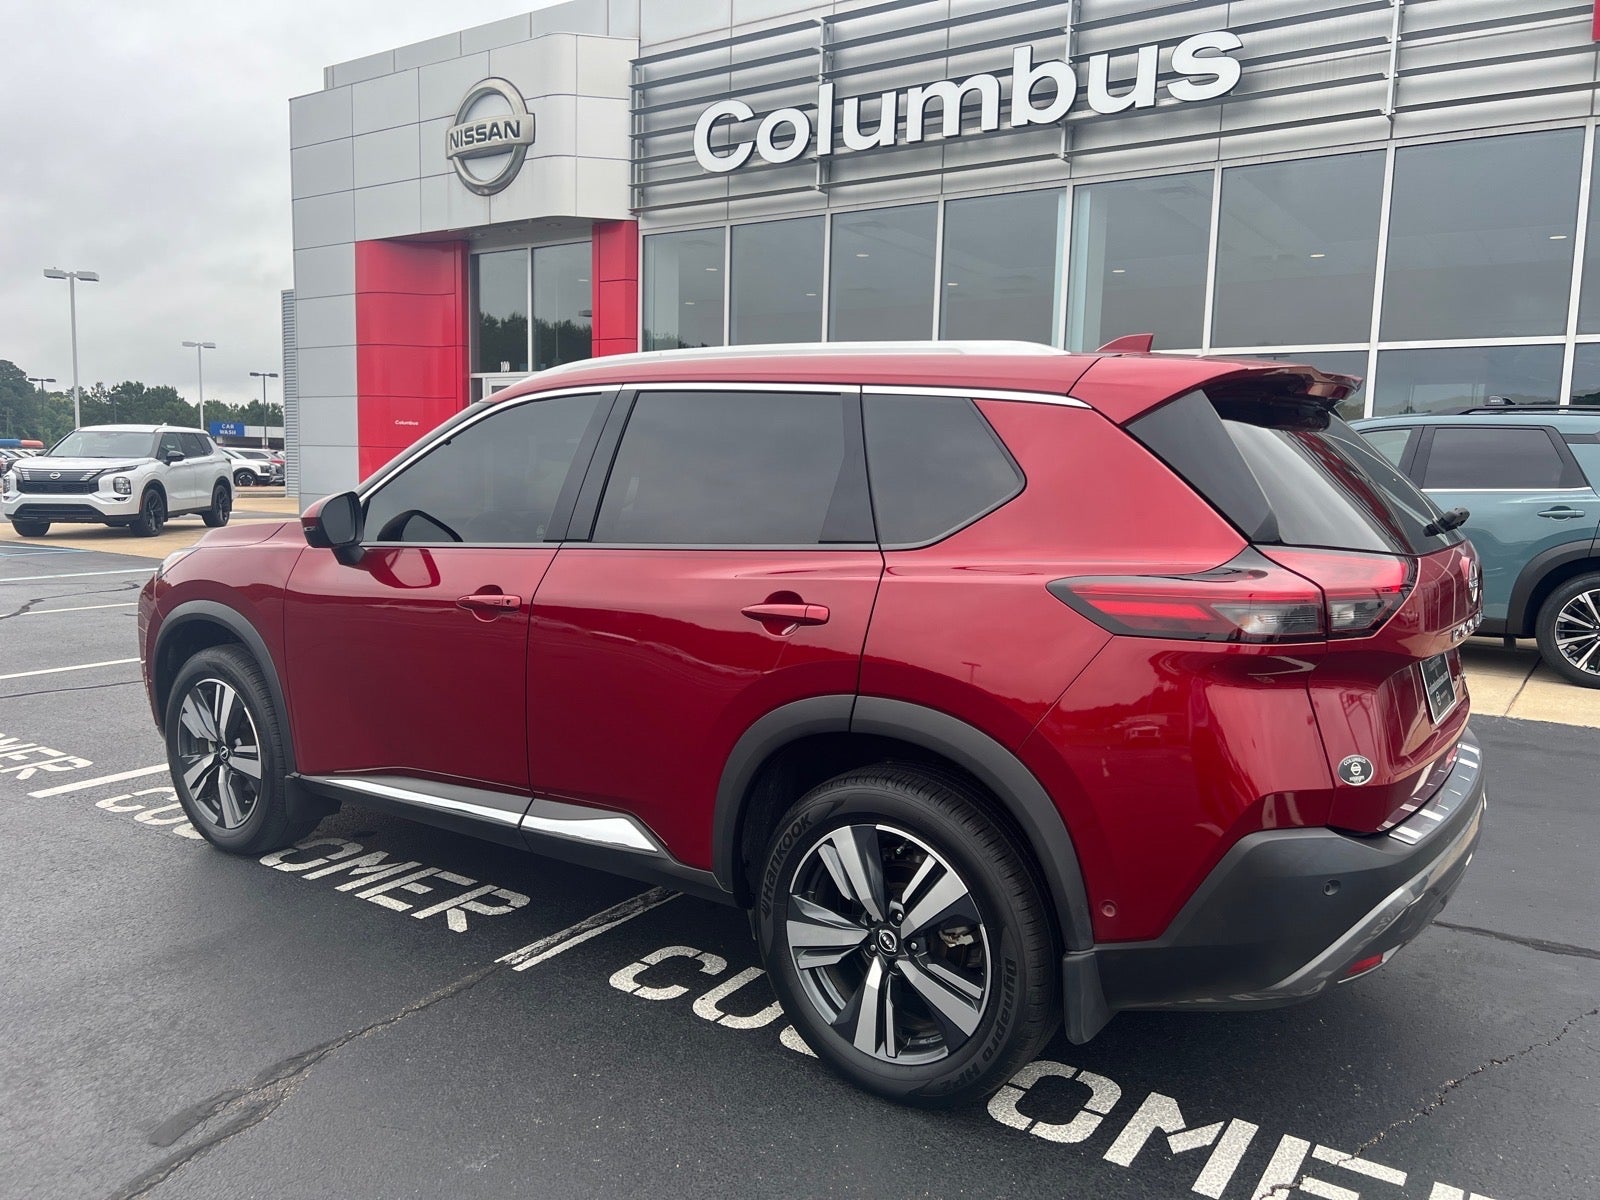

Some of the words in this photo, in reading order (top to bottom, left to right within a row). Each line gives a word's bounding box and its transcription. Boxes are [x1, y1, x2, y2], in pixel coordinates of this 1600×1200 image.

[449, 119, 521, 150] NISSAN
[693, 30, 1243, 172] Columbus
[983, 957, 1017, 1061] Dynapro
